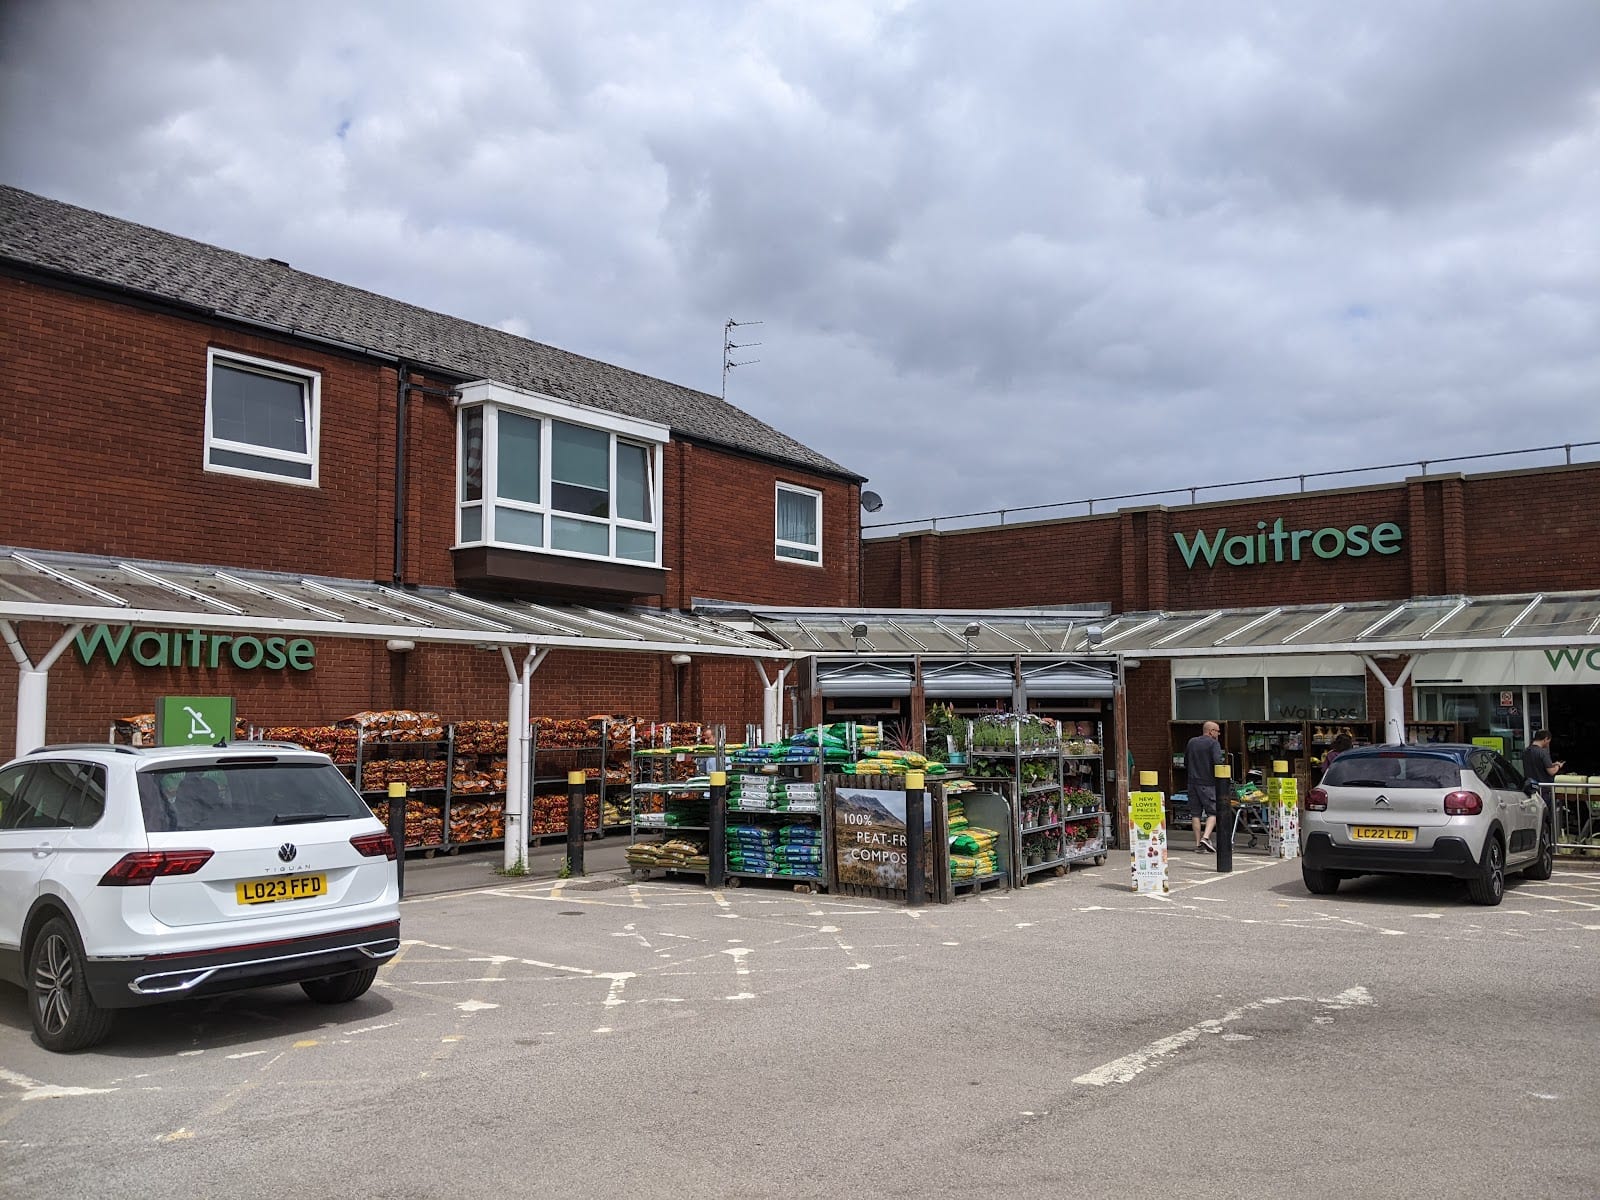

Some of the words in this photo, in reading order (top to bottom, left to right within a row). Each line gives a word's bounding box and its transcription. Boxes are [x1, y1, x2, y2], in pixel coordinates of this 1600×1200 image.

[1173, 517, 1402, 570] Waitrose
[75, 624, 316, 671] Waitrose
[843, 813, 872, 826] 100%
[856, 831, 908, 847] PEAT-FR
[1357, 828, 1385, 839] LC22
[1387, 829, 1408, 840] LZD
[851, 848, 908, 865] COMPOS
[243, 880, 287, 900] LO23
[291, 876, 321, 894] FFD
